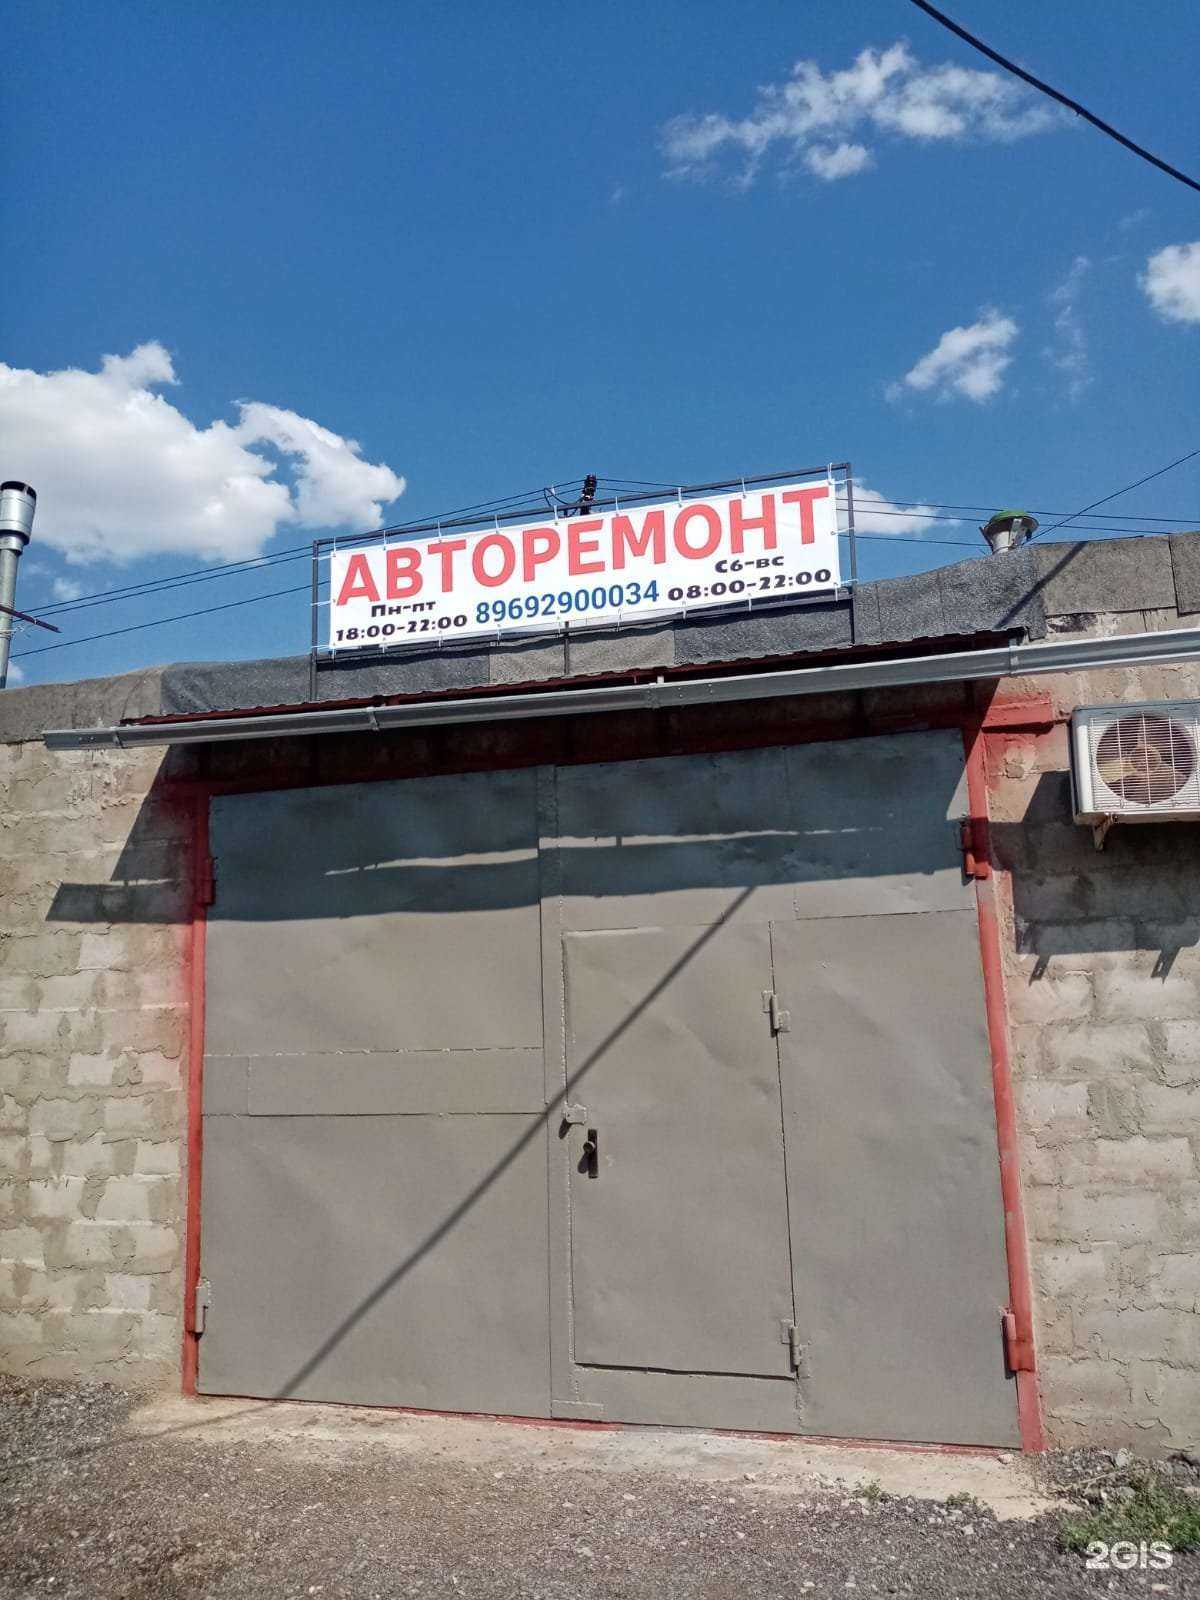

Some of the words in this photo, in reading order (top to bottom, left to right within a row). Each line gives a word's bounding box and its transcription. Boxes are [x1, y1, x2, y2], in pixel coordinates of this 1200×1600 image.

[336, 486, 829, 606] АВТОРЕМОНТ
[668, 569, 832, 601] 08:00-22:00
[371, 601, 436, 618] Пн-пт
[476, 580, 659, 624] 89692900034
[336, 614, 468, 641] 18:00-22:00
